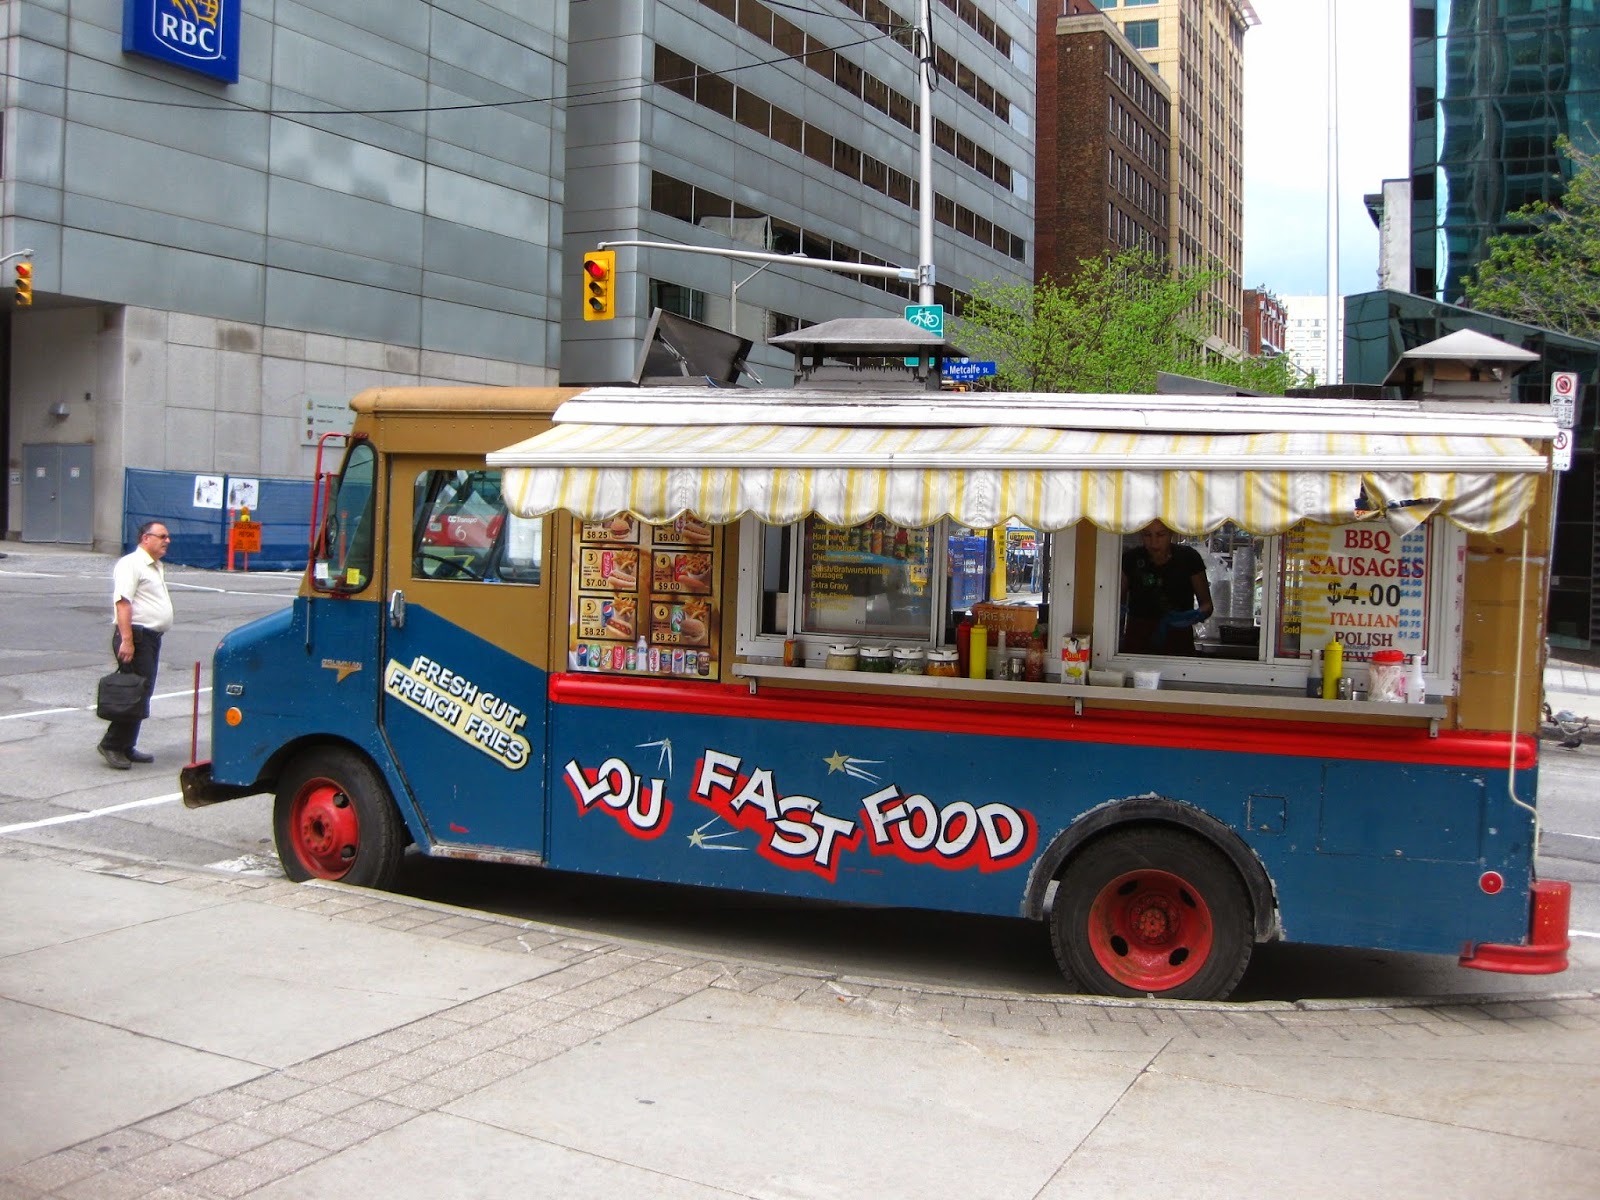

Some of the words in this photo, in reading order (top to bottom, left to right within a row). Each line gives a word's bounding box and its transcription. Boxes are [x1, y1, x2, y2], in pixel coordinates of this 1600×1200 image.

[162, 12, 214, 52] RBC
[949, 364, 981, 374] Metcalfe
[586, 531, 608, 539] $8.25
[658, 533, 680, 541] $9.00
[813, 533, 849, 542] Hamburger
[1344, 529, 1391, 553] BBQ
[588, 553, 594, 561] 3
[660, 557, 666, 565] 4
[1309, 556, 1424, 578] SAUSAGES
[811, 572, 844, 580] Sausages
[586, 579, 607, 587] $7.00
[658, 582, 680, 590] $9.00
[811, 581, 828, 589] Extra
[829, 582, 849, 591] Gravy
[1327, 581, 1401, 606] $4.00
[586, 602, 592, 611] 5
[659, 608, 665, 616] 6
[1330, 612, 1399, 628] ITALIAN
[584, 628, 605, 636] $8.25
[1398, 631, 1421, 639] $1.25
[656, 634, 677, 642] $8.25
[1335, 631, 1393, 647] POLISH
[415, 655, 479, 704] FRESH
[480, 692, 521, 728] CUT
[388, 669, 461, 724] FRENCH
[464, 714, 524, 763] FRIES
[564, 757, 665, 830] LOU
[697, 748, 857, 867] FAST
[861, 784, 1026, 859] FOOD
